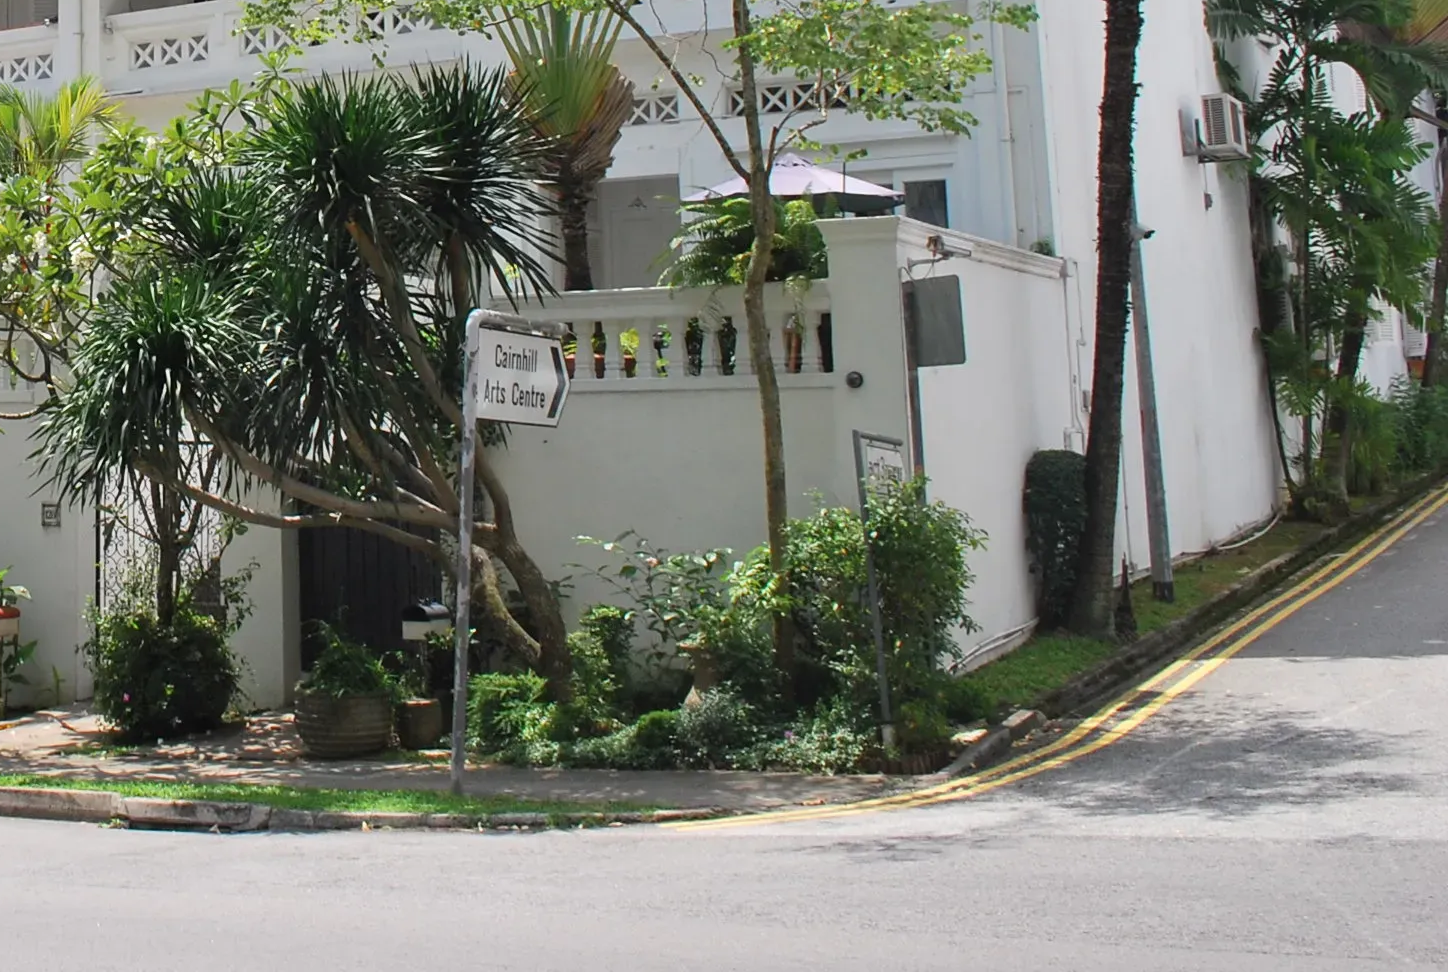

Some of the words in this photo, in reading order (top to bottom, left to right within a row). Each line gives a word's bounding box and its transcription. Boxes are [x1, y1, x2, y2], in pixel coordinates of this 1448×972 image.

[495, 344, 538, 372] Cairnhill
[483, 378, 506, 404] Arts
[511, 382, 546, 408] Centre
